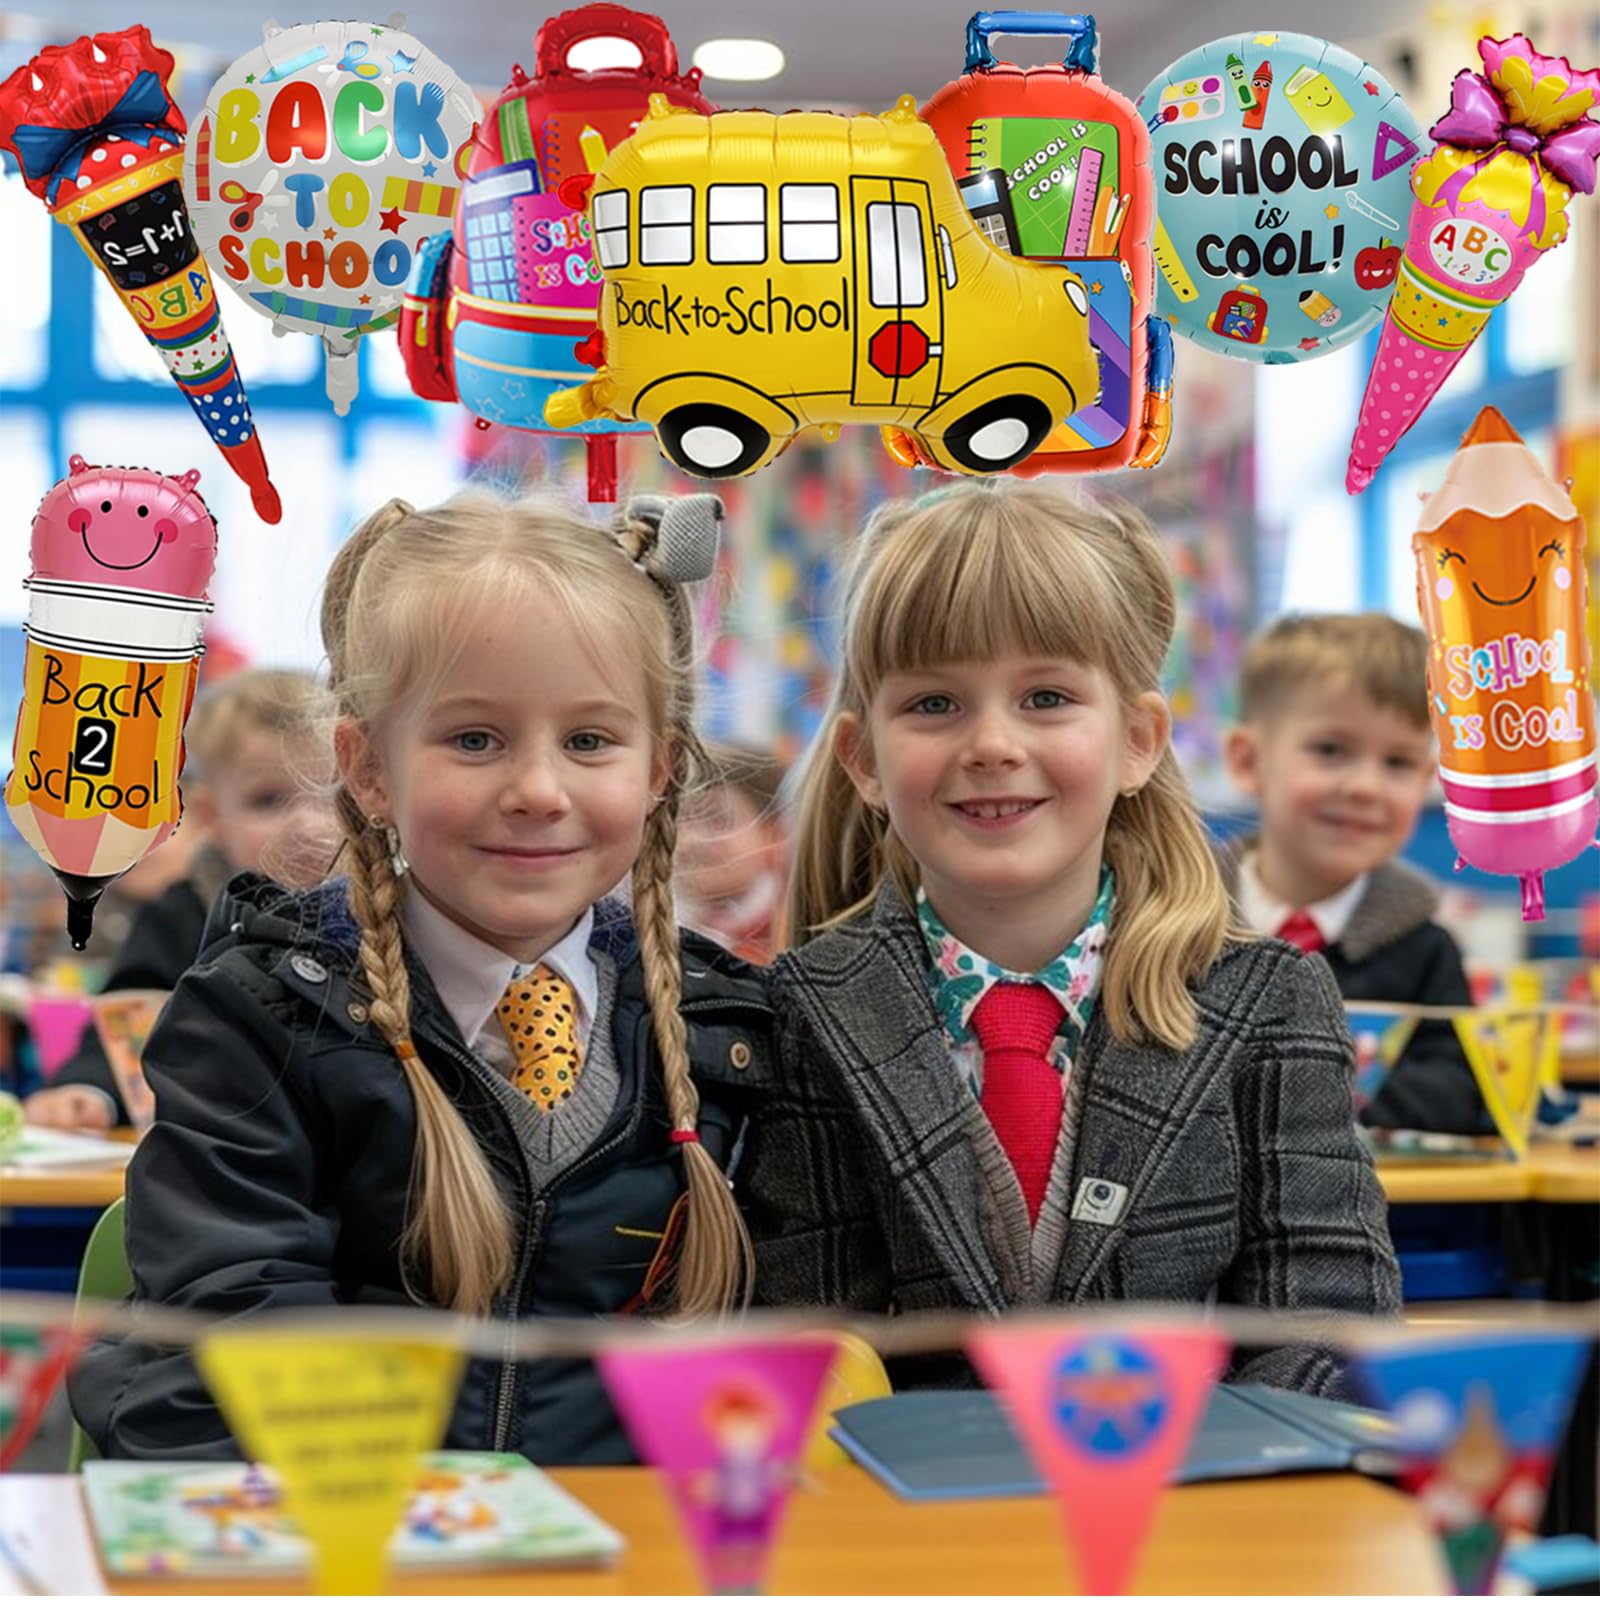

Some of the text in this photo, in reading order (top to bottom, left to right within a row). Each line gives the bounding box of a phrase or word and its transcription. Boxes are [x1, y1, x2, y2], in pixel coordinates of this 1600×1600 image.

[214, 81, 450, 166] BACK
[1005, 121, 1088, 191] SCHOOL IS
[1164, 134, 1359, 194] SCHOOL
[284, 172, 371, 230] TO
[1254, 199, 1289, 229] is
[532, 212, 591, 252] SCHO
[1196, 224, 1344, 279] COOL!
[218, 235, 427, 288] SCHOO
[565, 254, 603, 284] CO
[614, 277, 850, 335] Back-to-School
[43, 654, 164, 718] Back
[80, 725, 108, 768] 2
[24, 750, 159, 810] School
